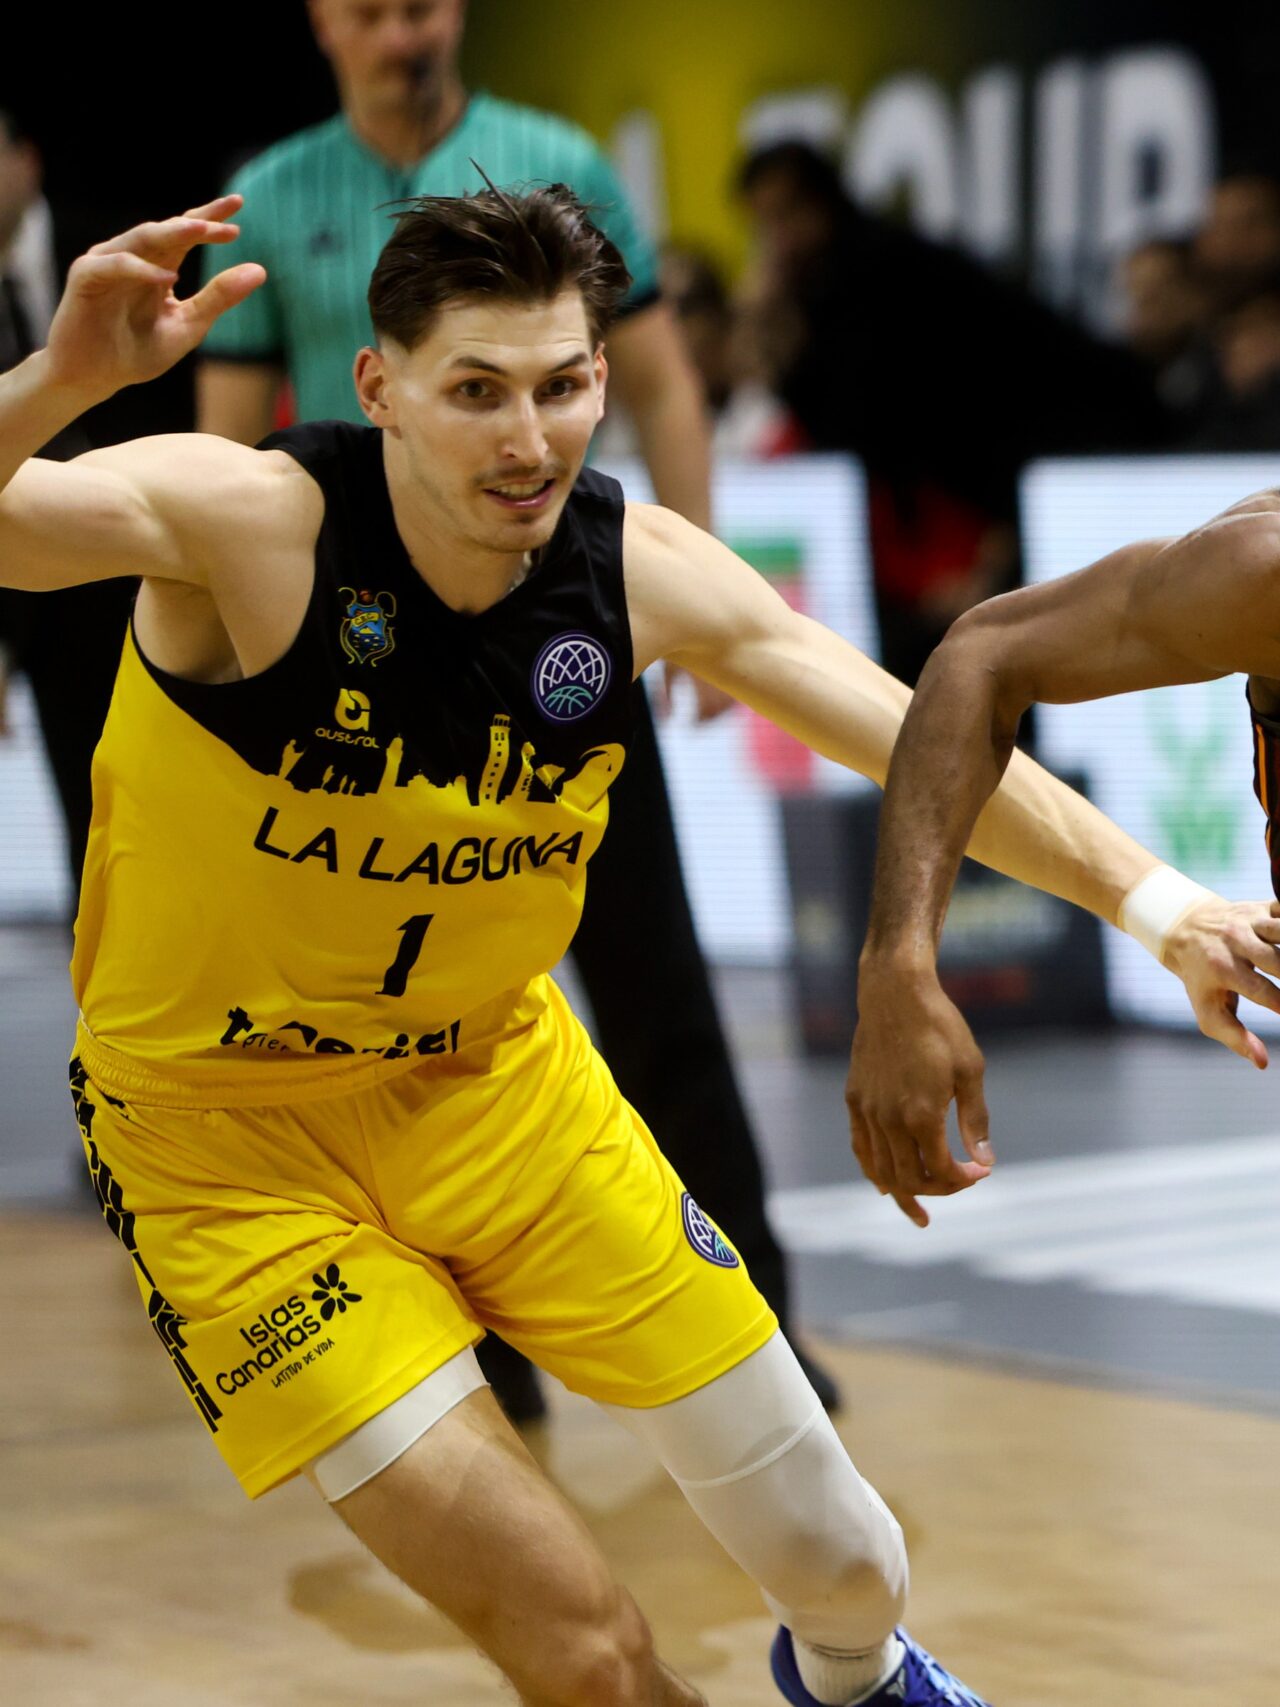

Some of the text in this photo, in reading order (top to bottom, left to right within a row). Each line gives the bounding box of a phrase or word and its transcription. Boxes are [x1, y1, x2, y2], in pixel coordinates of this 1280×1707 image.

[315, 727, 380, 749] austral
[253, 806, 584, 885] LA LAGUNA
[375, 914, 435, 998] 1
[239, 1295, 306, 1349] Islas
[302, 1350, 317, 1365] DE
[313, 1337, 336, 1356] VIDA
[215, 1315, 321, 1396] Canarias
